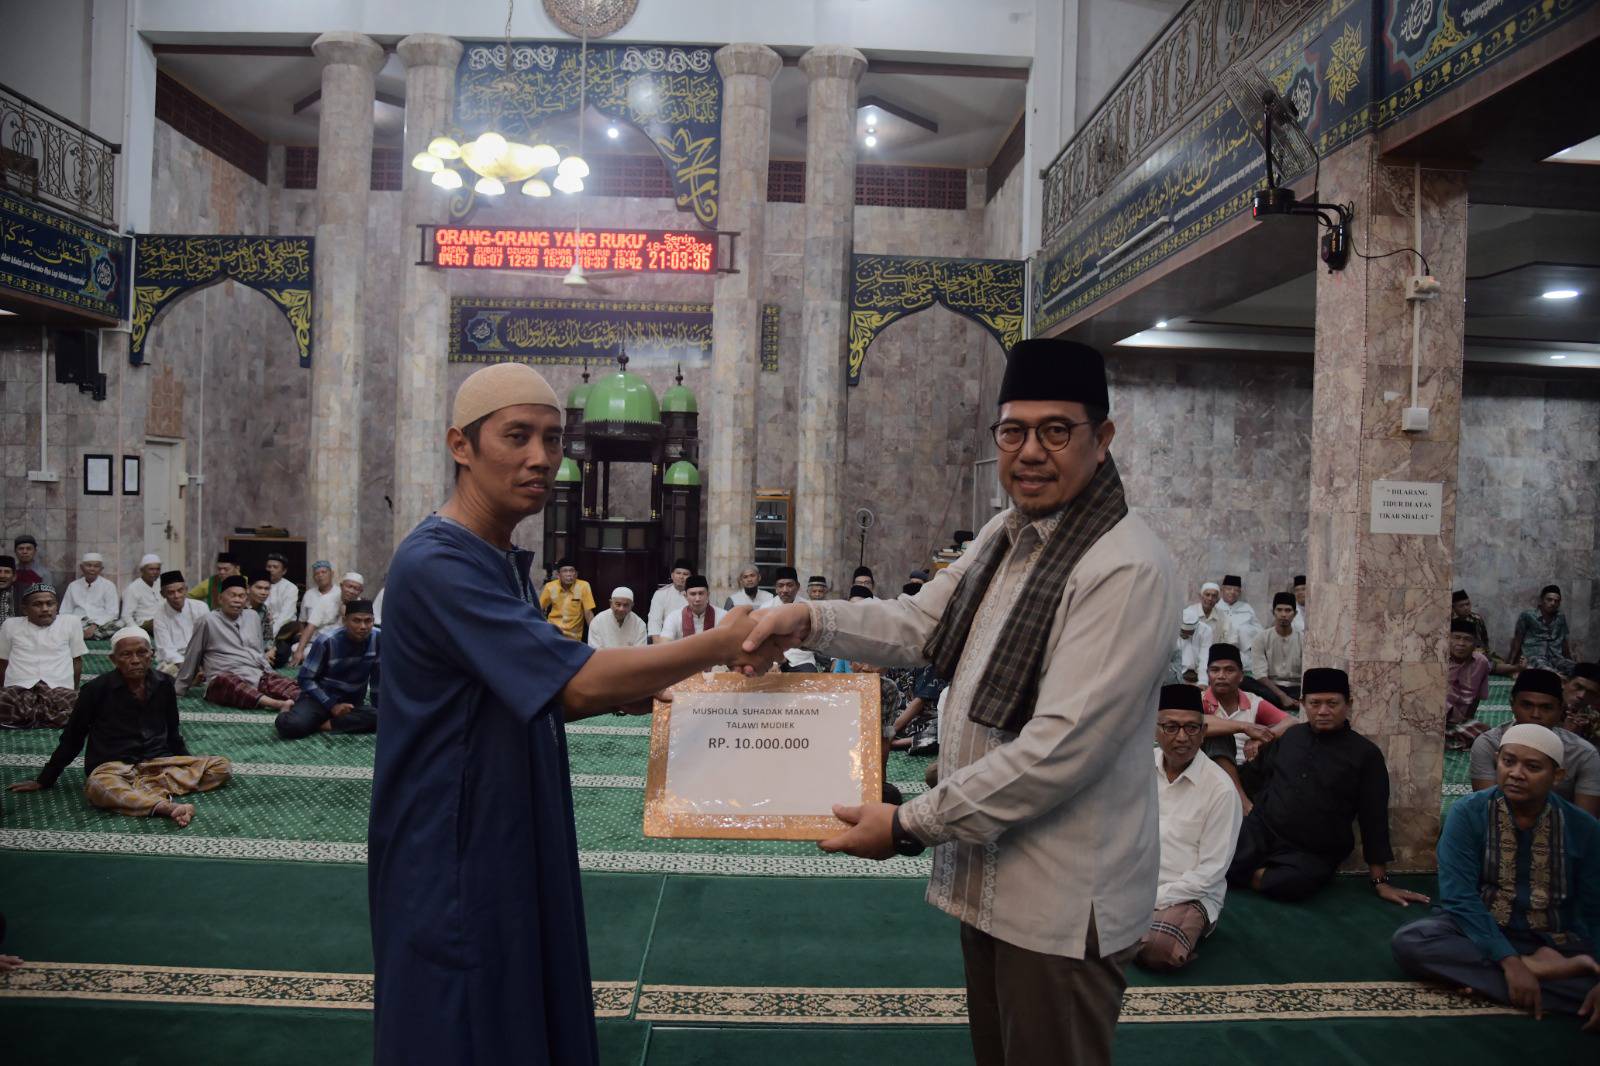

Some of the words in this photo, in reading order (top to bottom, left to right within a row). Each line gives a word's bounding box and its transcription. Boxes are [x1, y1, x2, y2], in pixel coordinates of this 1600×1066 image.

[436, 229, 550, 246] ORANG-ORANG
[553, 231, 597, 248] YANG
[664, 233, 696, 244] Senin
[647, 242, 713, 253] 18-03-2024
[473, 254, 504, 267] 05:07
[508, 255, 538, 268] 12:29
[742, 708, 782, 716] SUHADAK
[785, 708, 819, 716] MAKAM
[726, 721, 759, 729] TALAWI
[761, 721, 795, 729] MUDIEK
[708, 737, 729, 749] RP.
[735, 738, 810, 750] 10.000.000
